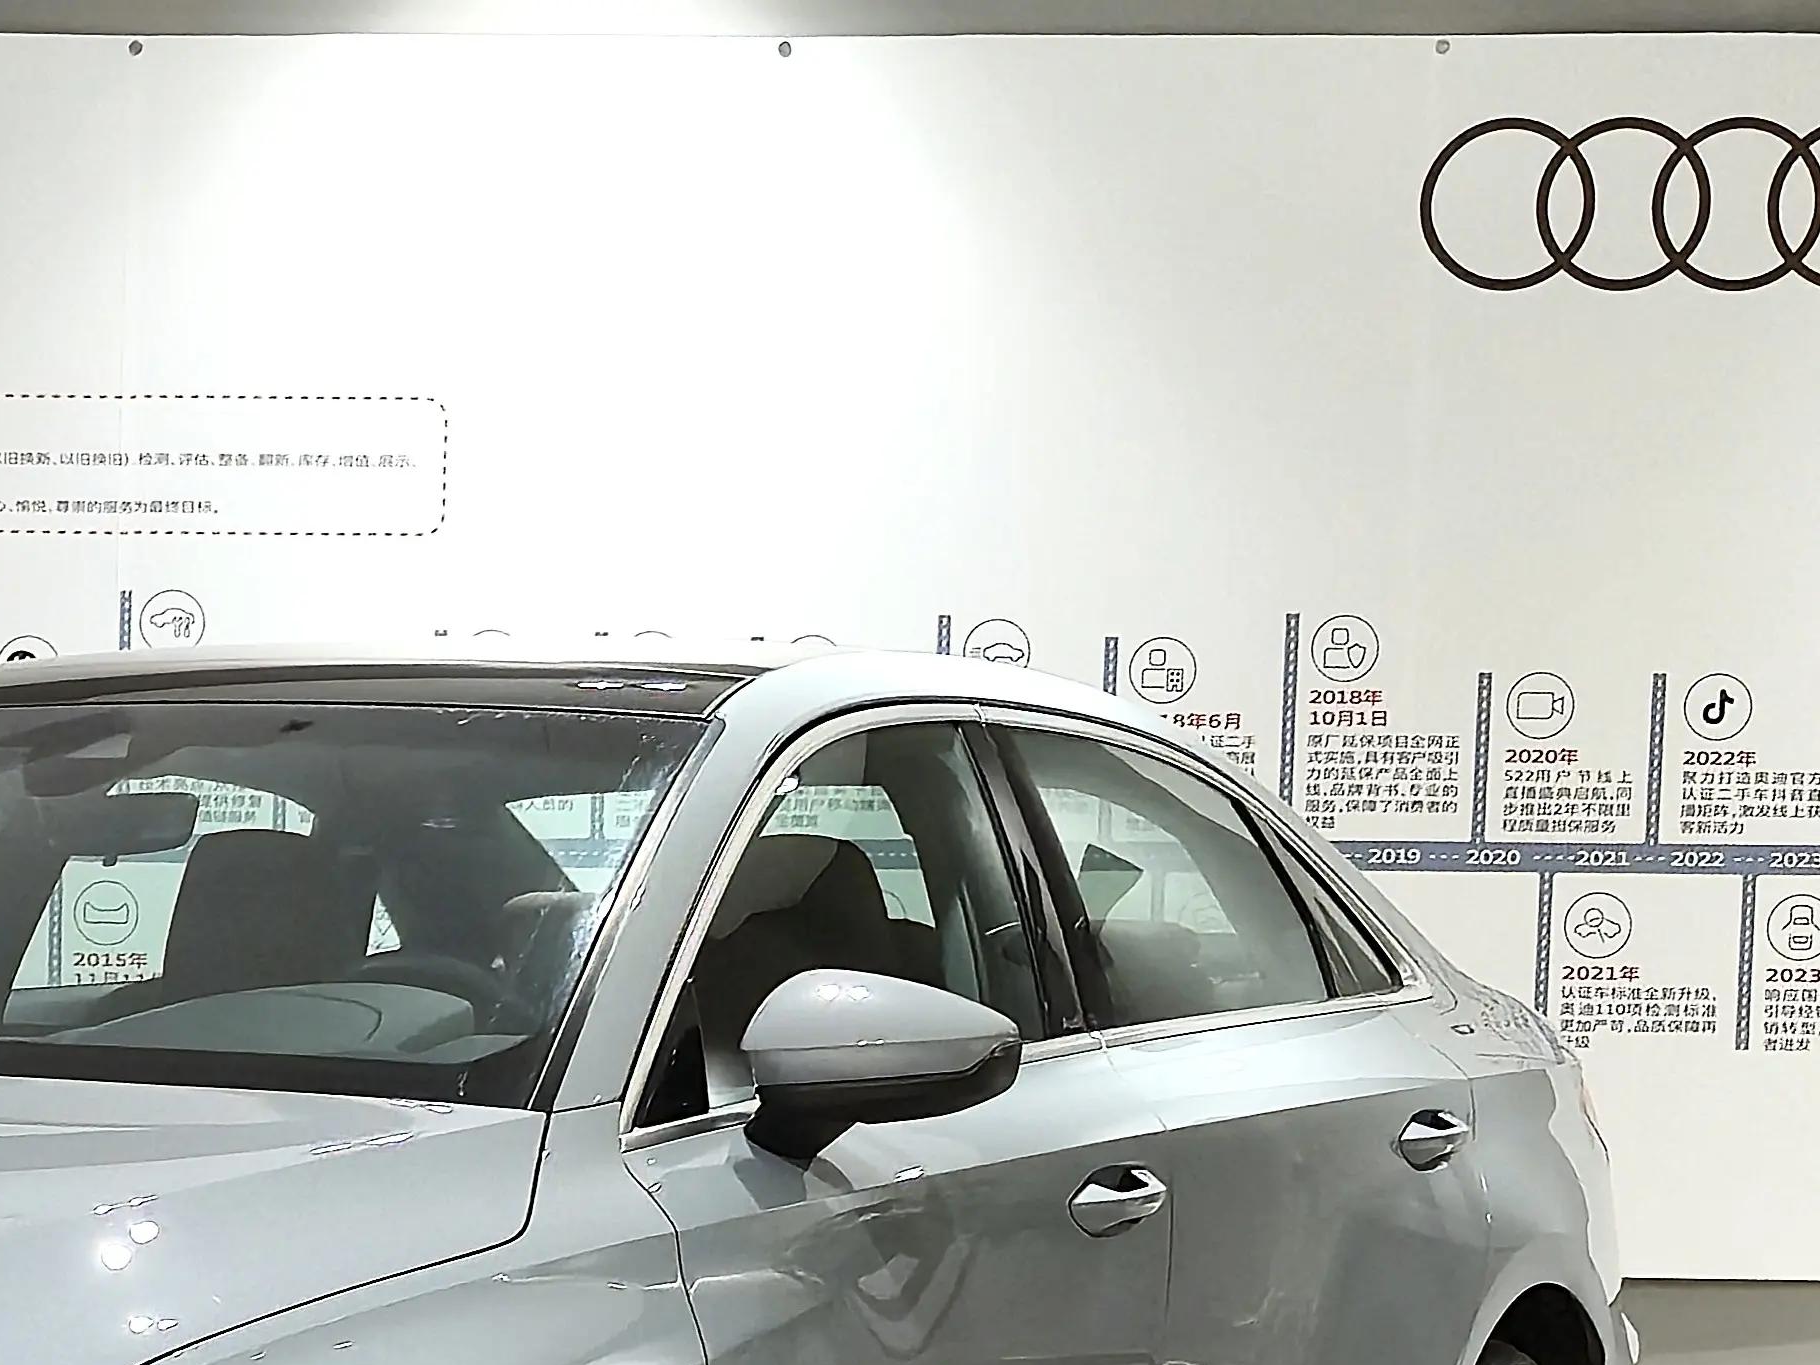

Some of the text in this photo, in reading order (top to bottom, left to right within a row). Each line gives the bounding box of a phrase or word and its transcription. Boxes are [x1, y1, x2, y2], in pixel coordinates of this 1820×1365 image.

[1309, 690, 1383, 706] 2018年
[1160, 713, 1241, 730] 8年6月
[1309, 711, 1387, 727] 10月1日
[1202, 735, 1255, 749] 证二手
[1505, 749, 1578, 765] 2020年
[1683, 751, 1756, 767] 2022年
[1367, 848, 1421, 864] 2019
[1465, 850, 1521, 866] 2020
[1574, 850, 1630, 867] 2021
[1670, 852, 1725, 867] 2022
[1769, 852, 1820, 869] 2023
[73, 953, 148, 968] 2015年
[1562, 966, 1640, 982] 2021年
